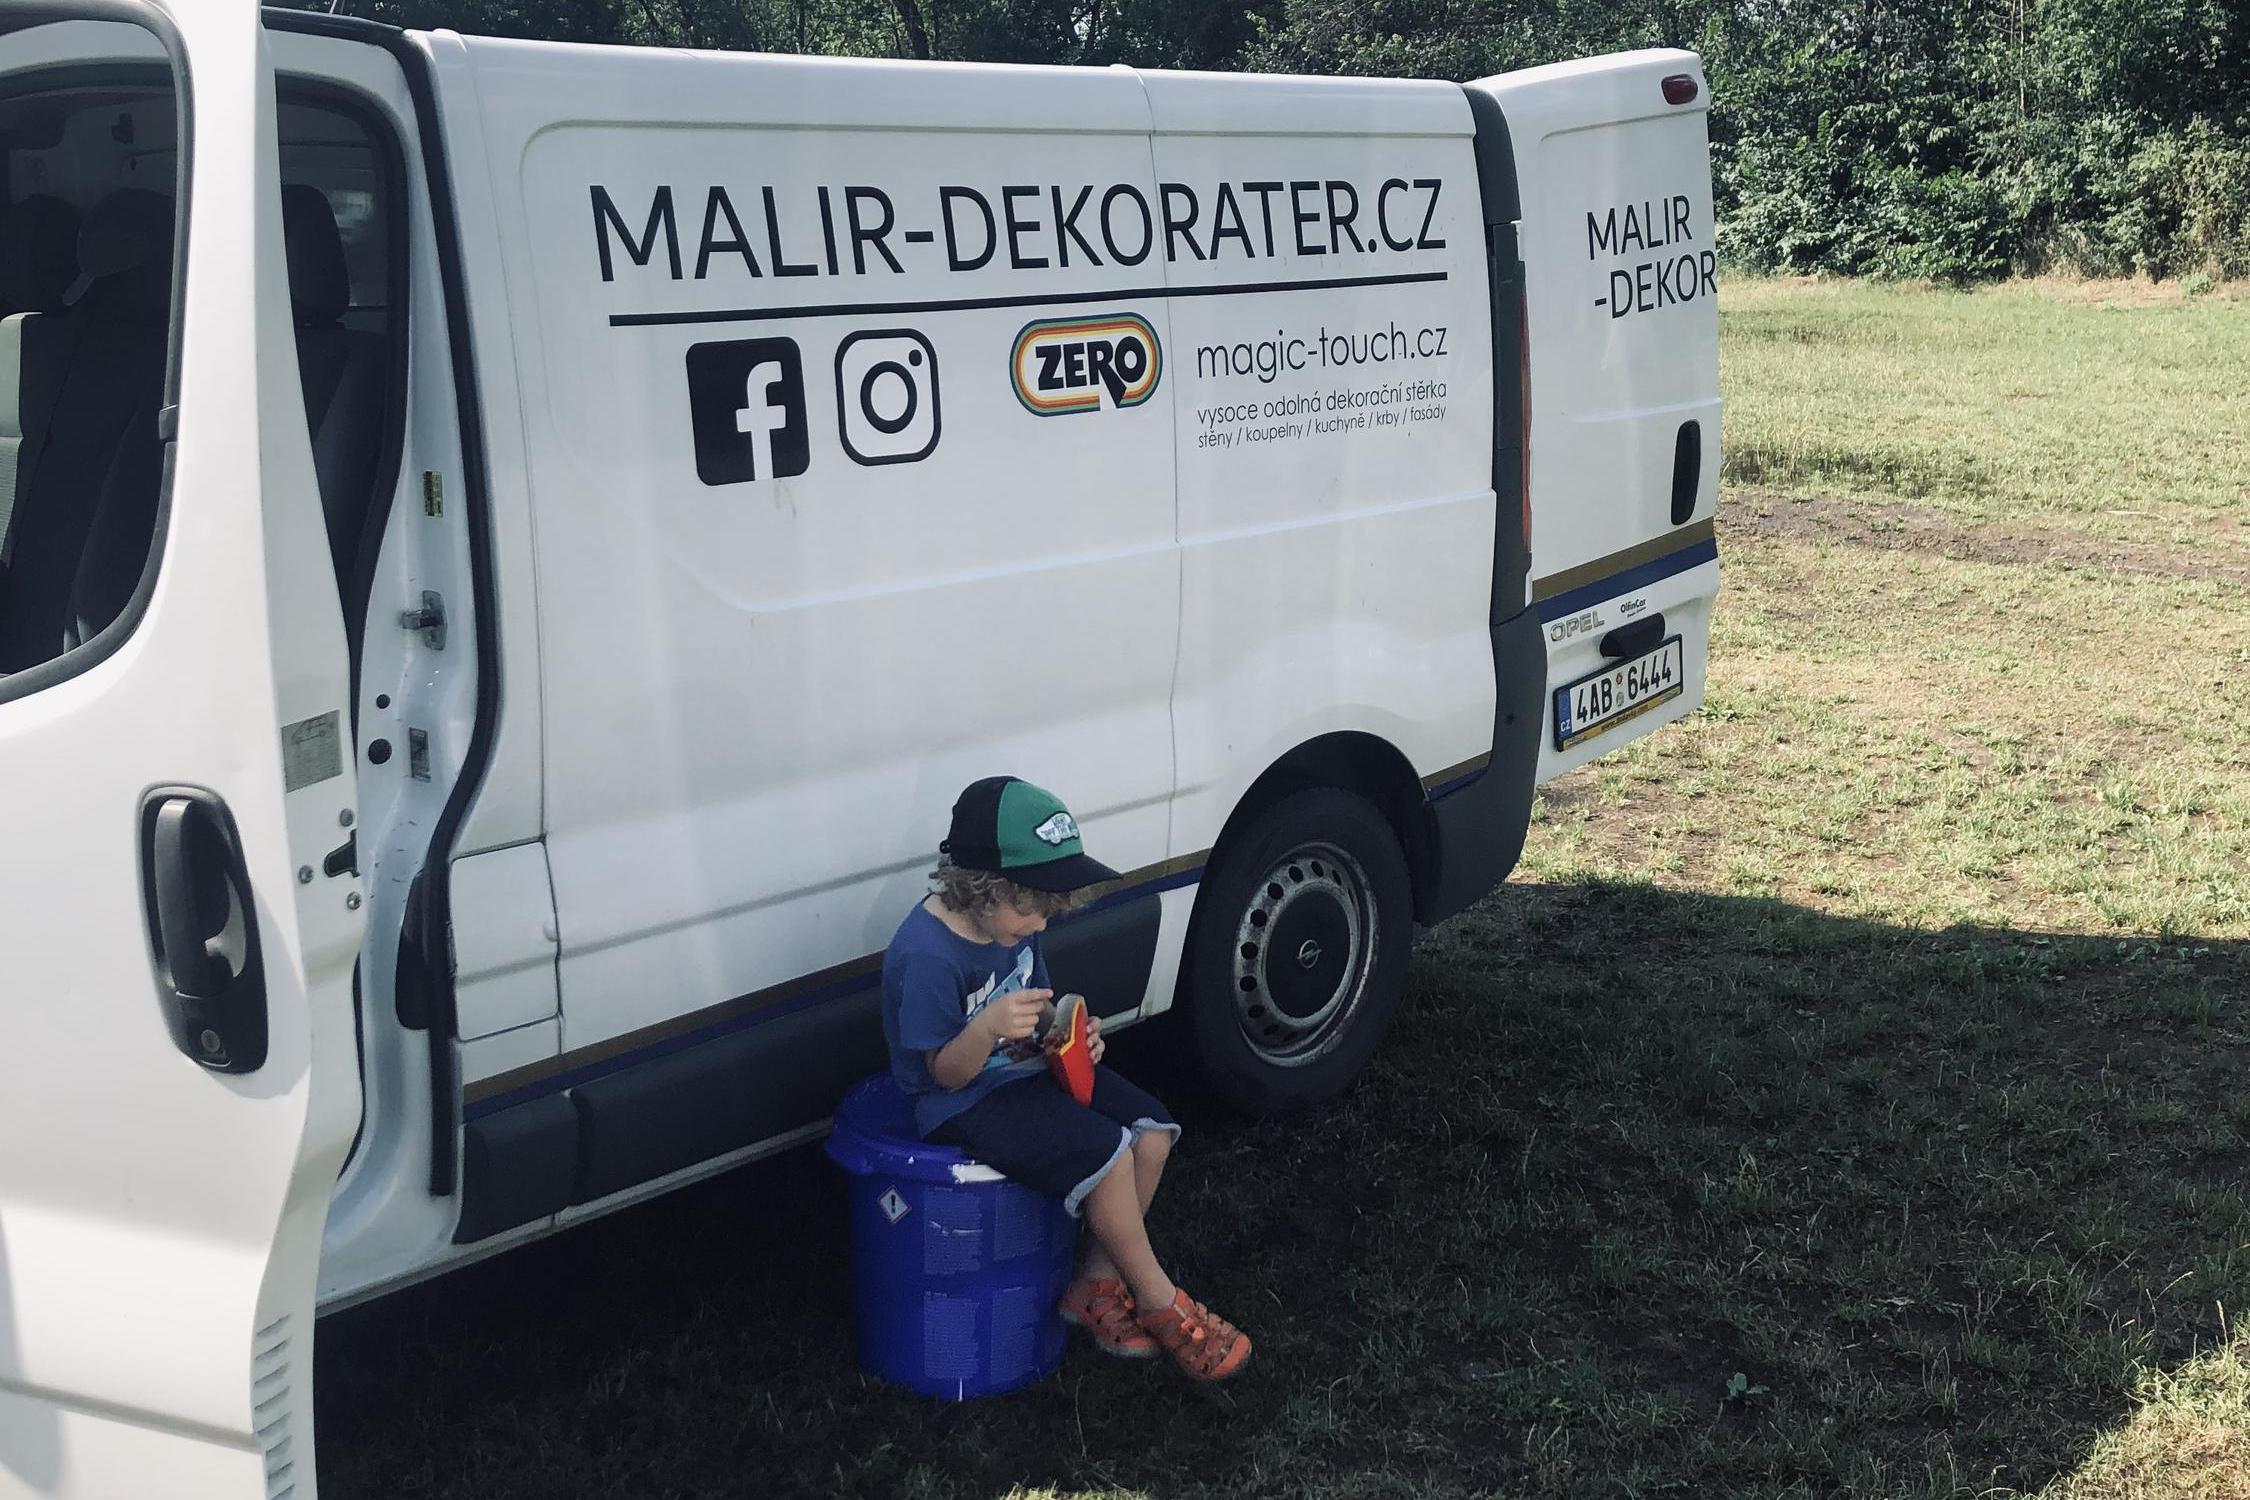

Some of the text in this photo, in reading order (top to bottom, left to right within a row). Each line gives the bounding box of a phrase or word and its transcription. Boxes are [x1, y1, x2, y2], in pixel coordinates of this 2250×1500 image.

[590, 178, 1447, 282] MALIR-DEKORATER.CZ
[1587, 195, 1692, 260] MALIR
[1594, 250, 1718, 319] -DEKOR
[1036, 335, 1147, 409] ZERO
[1197, 321, 1448, 384] magic-touch.cz
[1198, 380, 1447, 429] vysoce odolná dekorační stěrka
[1198, 428, 1233, 449] stěny
[1246, 422, 1304, 444] koupelny
[1315, 415, 1365, 434] kuchyně
[1376, 409, 1400, 426] krby
[1410, 404, 1446, 422] fasády
[1550, 611, 1605, 642] OPEL
[1576, 678, 1612, 724] 4AB
[1627, 650, 1672, 700] 6444
[1560, 719, 1572, 733] CZ
